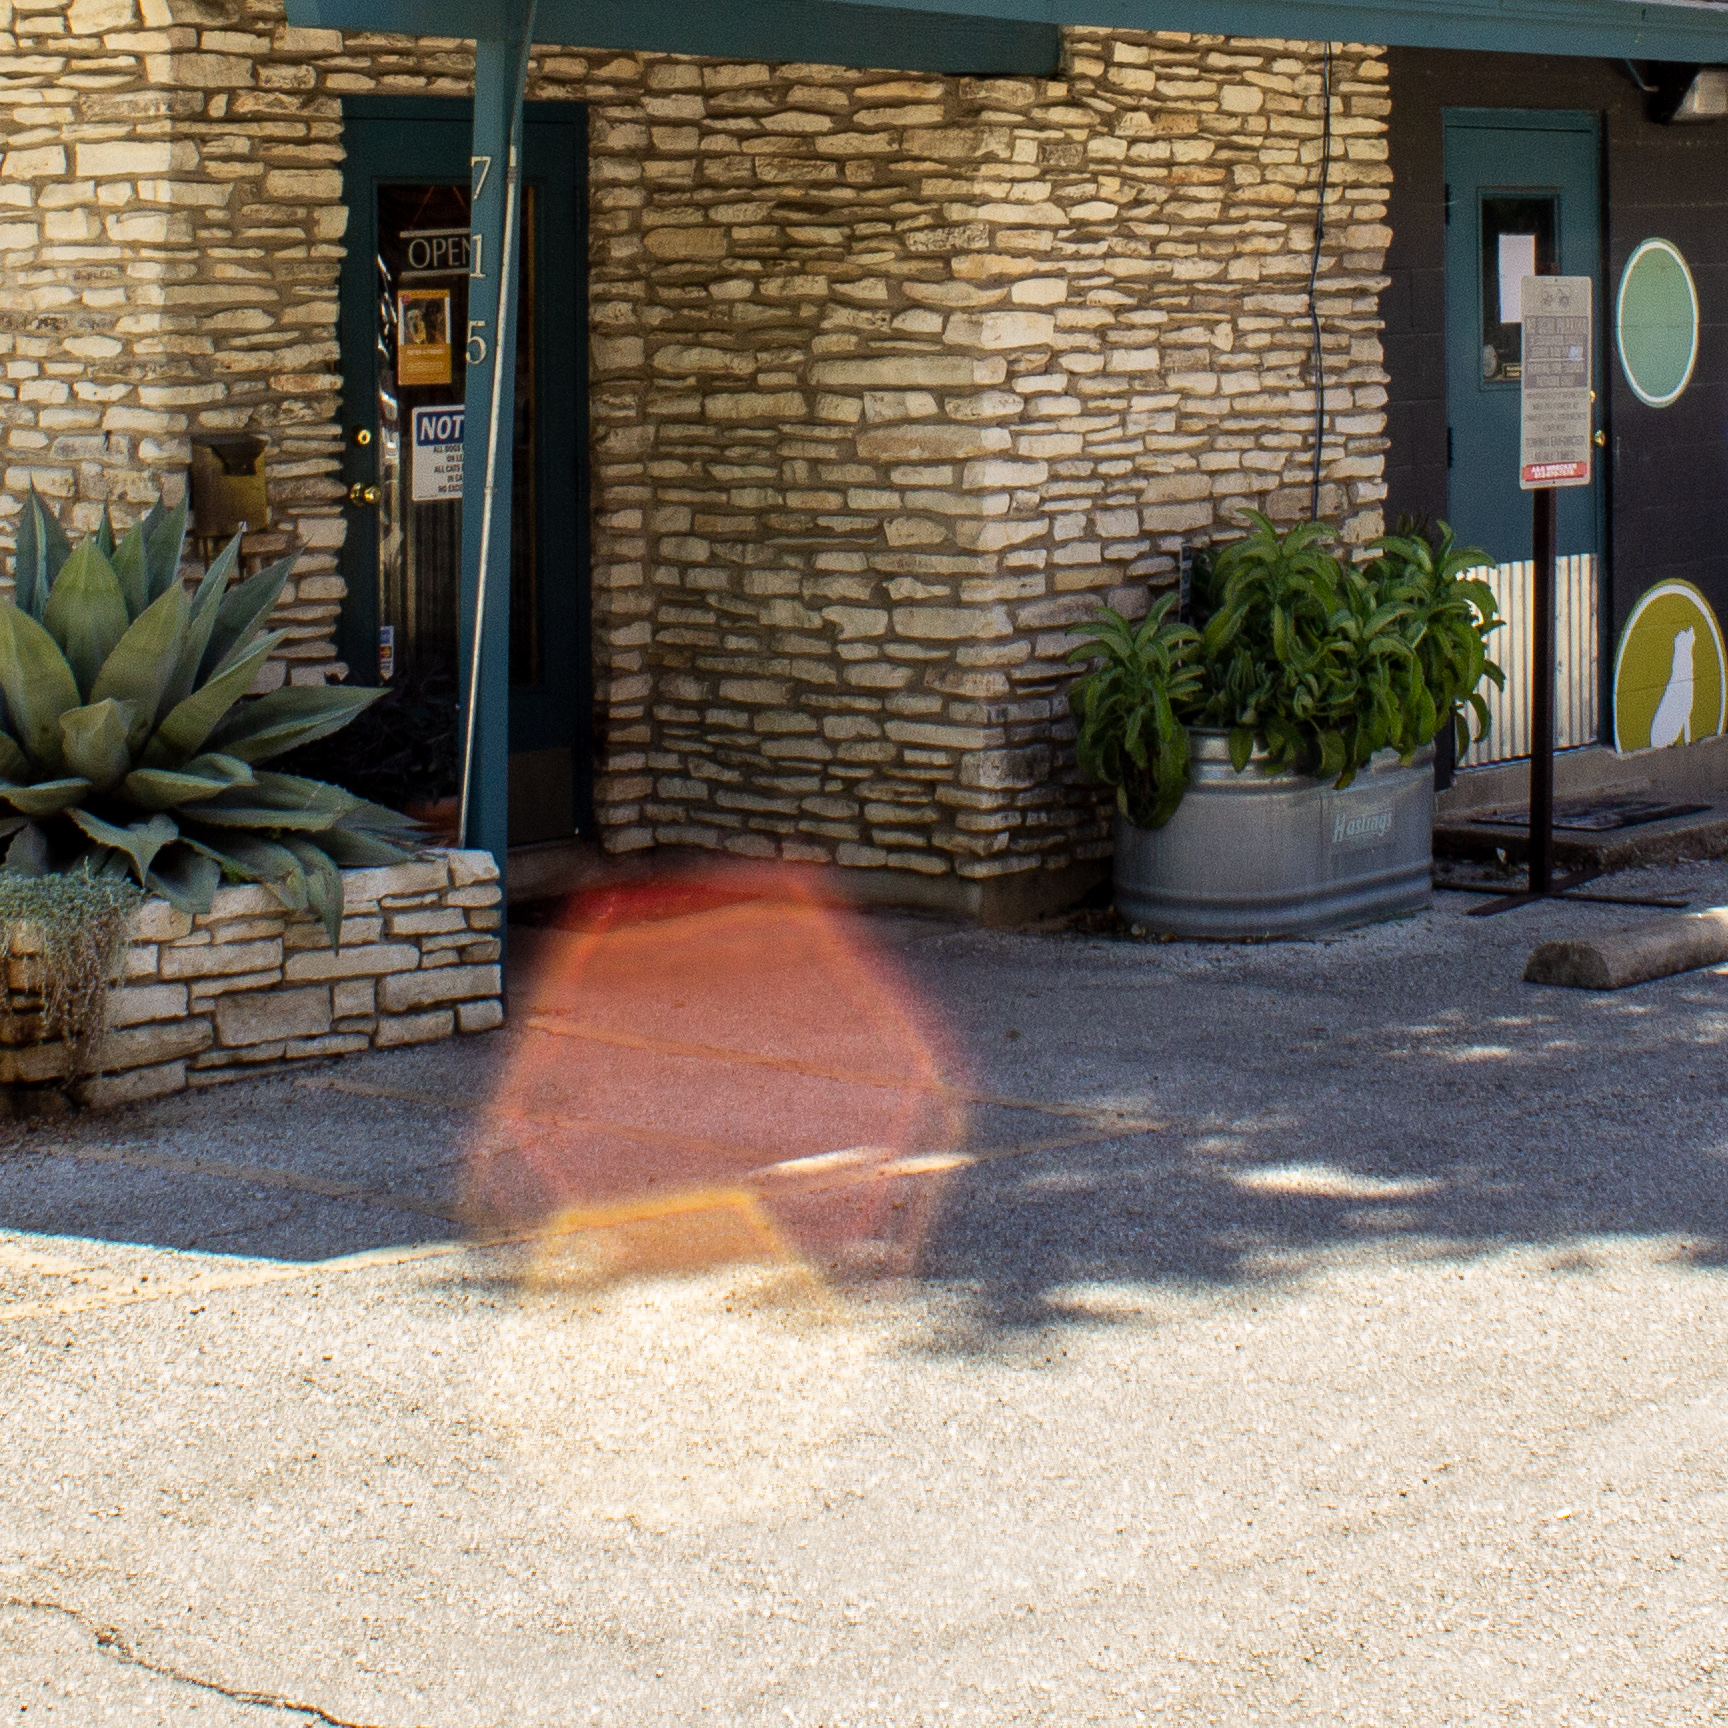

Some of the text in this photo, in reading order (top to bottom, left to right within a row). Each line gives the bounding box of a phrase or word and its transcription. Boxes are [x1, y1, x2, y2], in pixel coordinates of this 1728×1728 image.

[408, 238, 470, 269] OPEN
[434, 463, 461, 473] ALL CATS
[1333, 812, 1392, 843] Hastings
